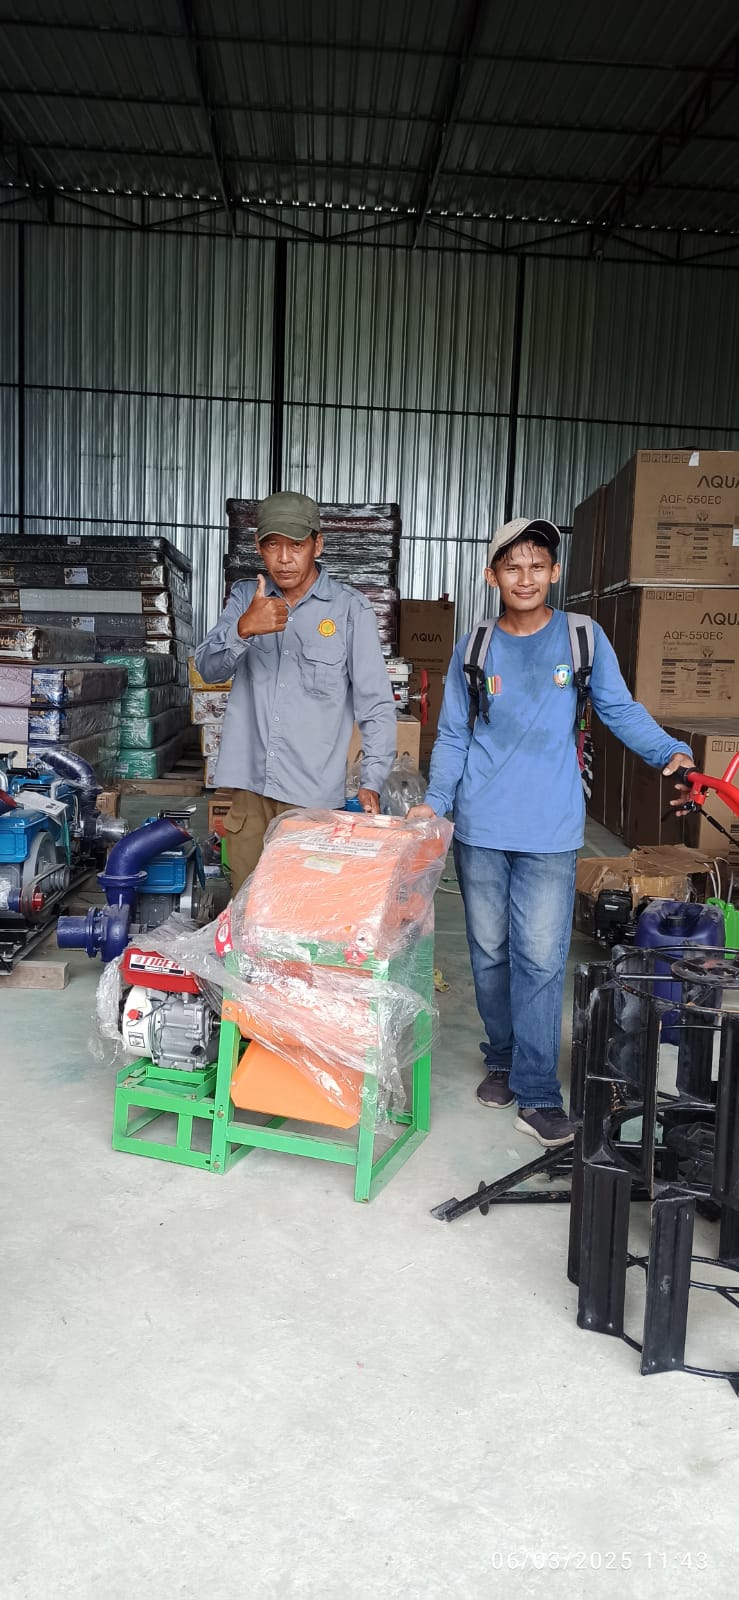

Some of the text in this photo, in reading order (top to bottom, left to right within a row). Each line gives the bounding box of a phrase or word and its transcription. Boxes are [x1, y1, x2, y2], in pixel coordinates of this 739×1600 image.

[700, 612, 739, 626] AQU
[411, 632, 442, 642] AQUA
[663, 631, 723, 641] AQF-550EC
